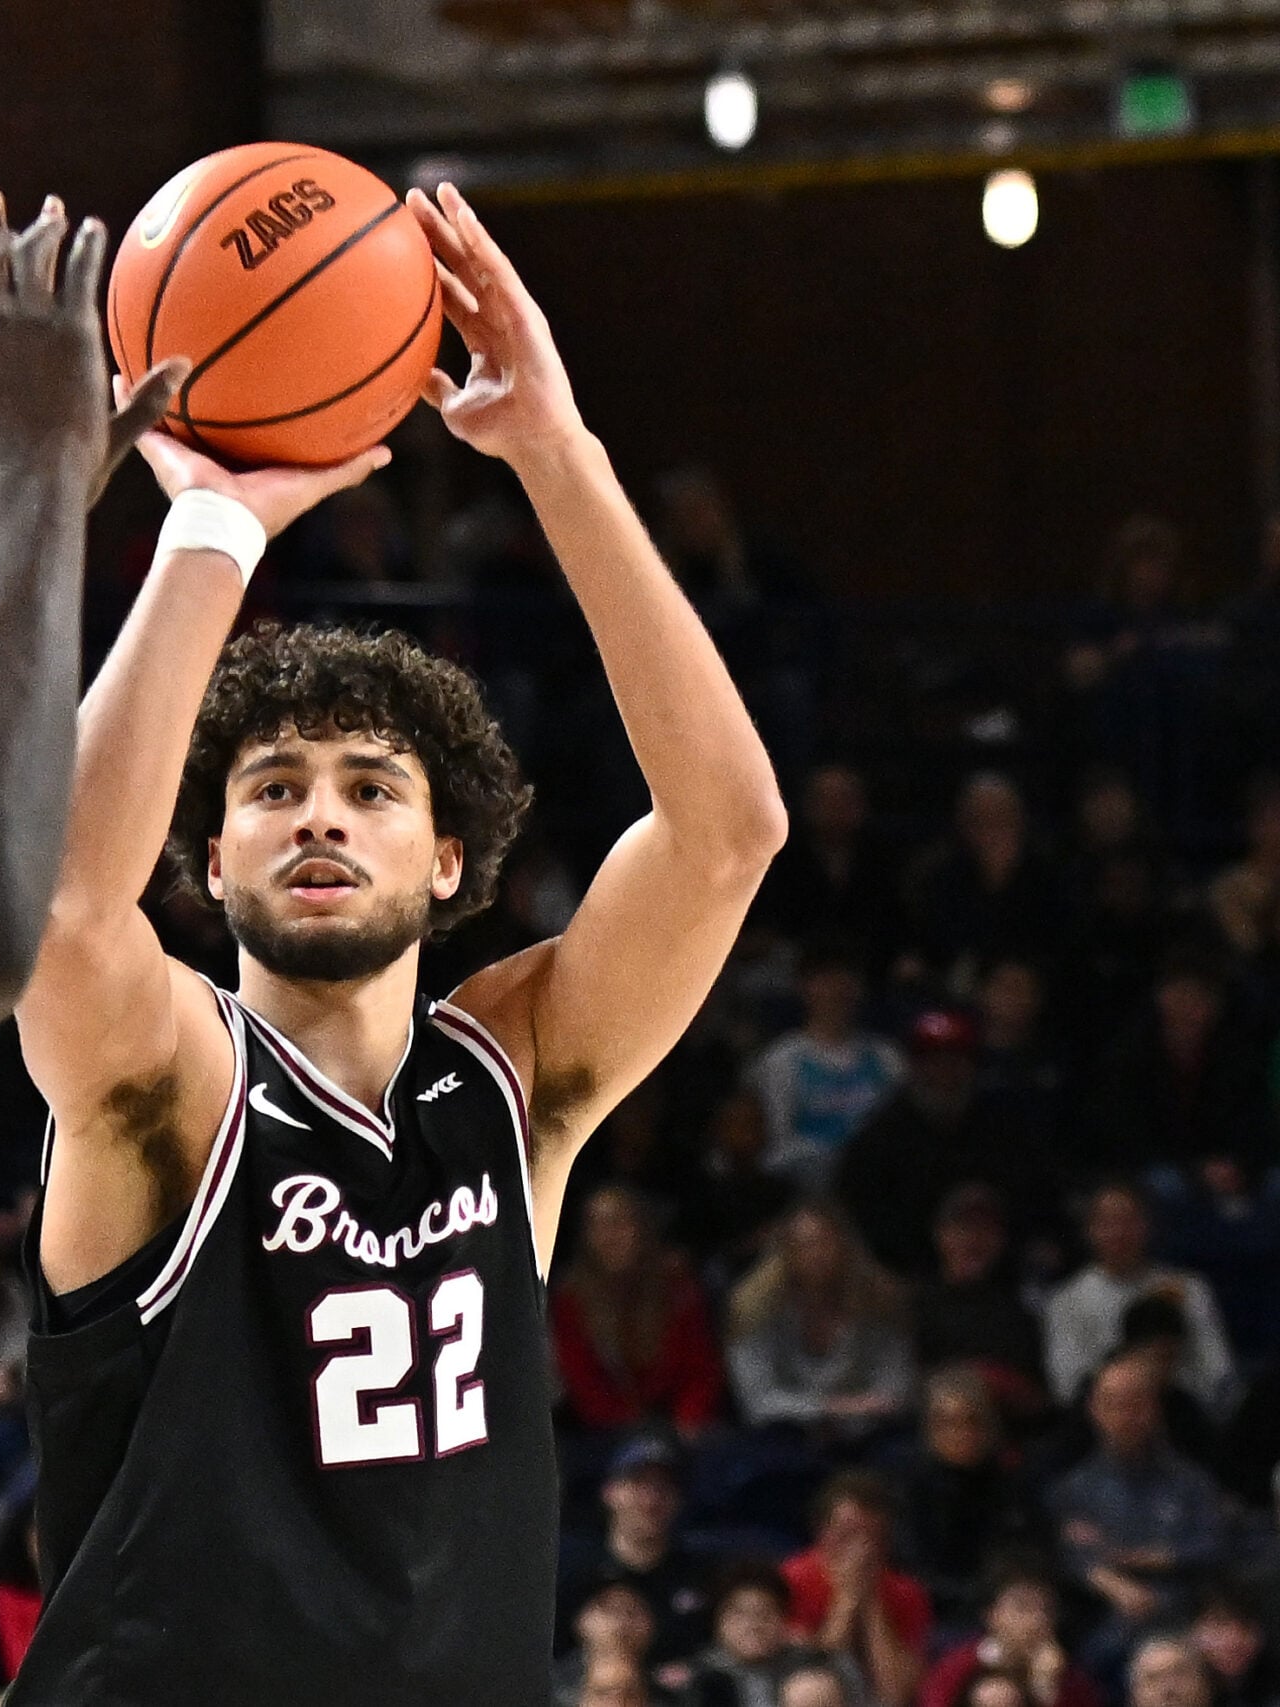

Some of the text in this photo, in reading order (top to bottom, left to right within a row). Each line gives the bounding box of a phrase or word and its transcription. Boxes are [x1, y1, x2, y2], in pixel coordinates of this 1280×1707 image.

[220, 178, 336, 270] ZAGS
[261, 1170, 498, 1268] Broncos
[305, 1267, 489, 1469] 22
